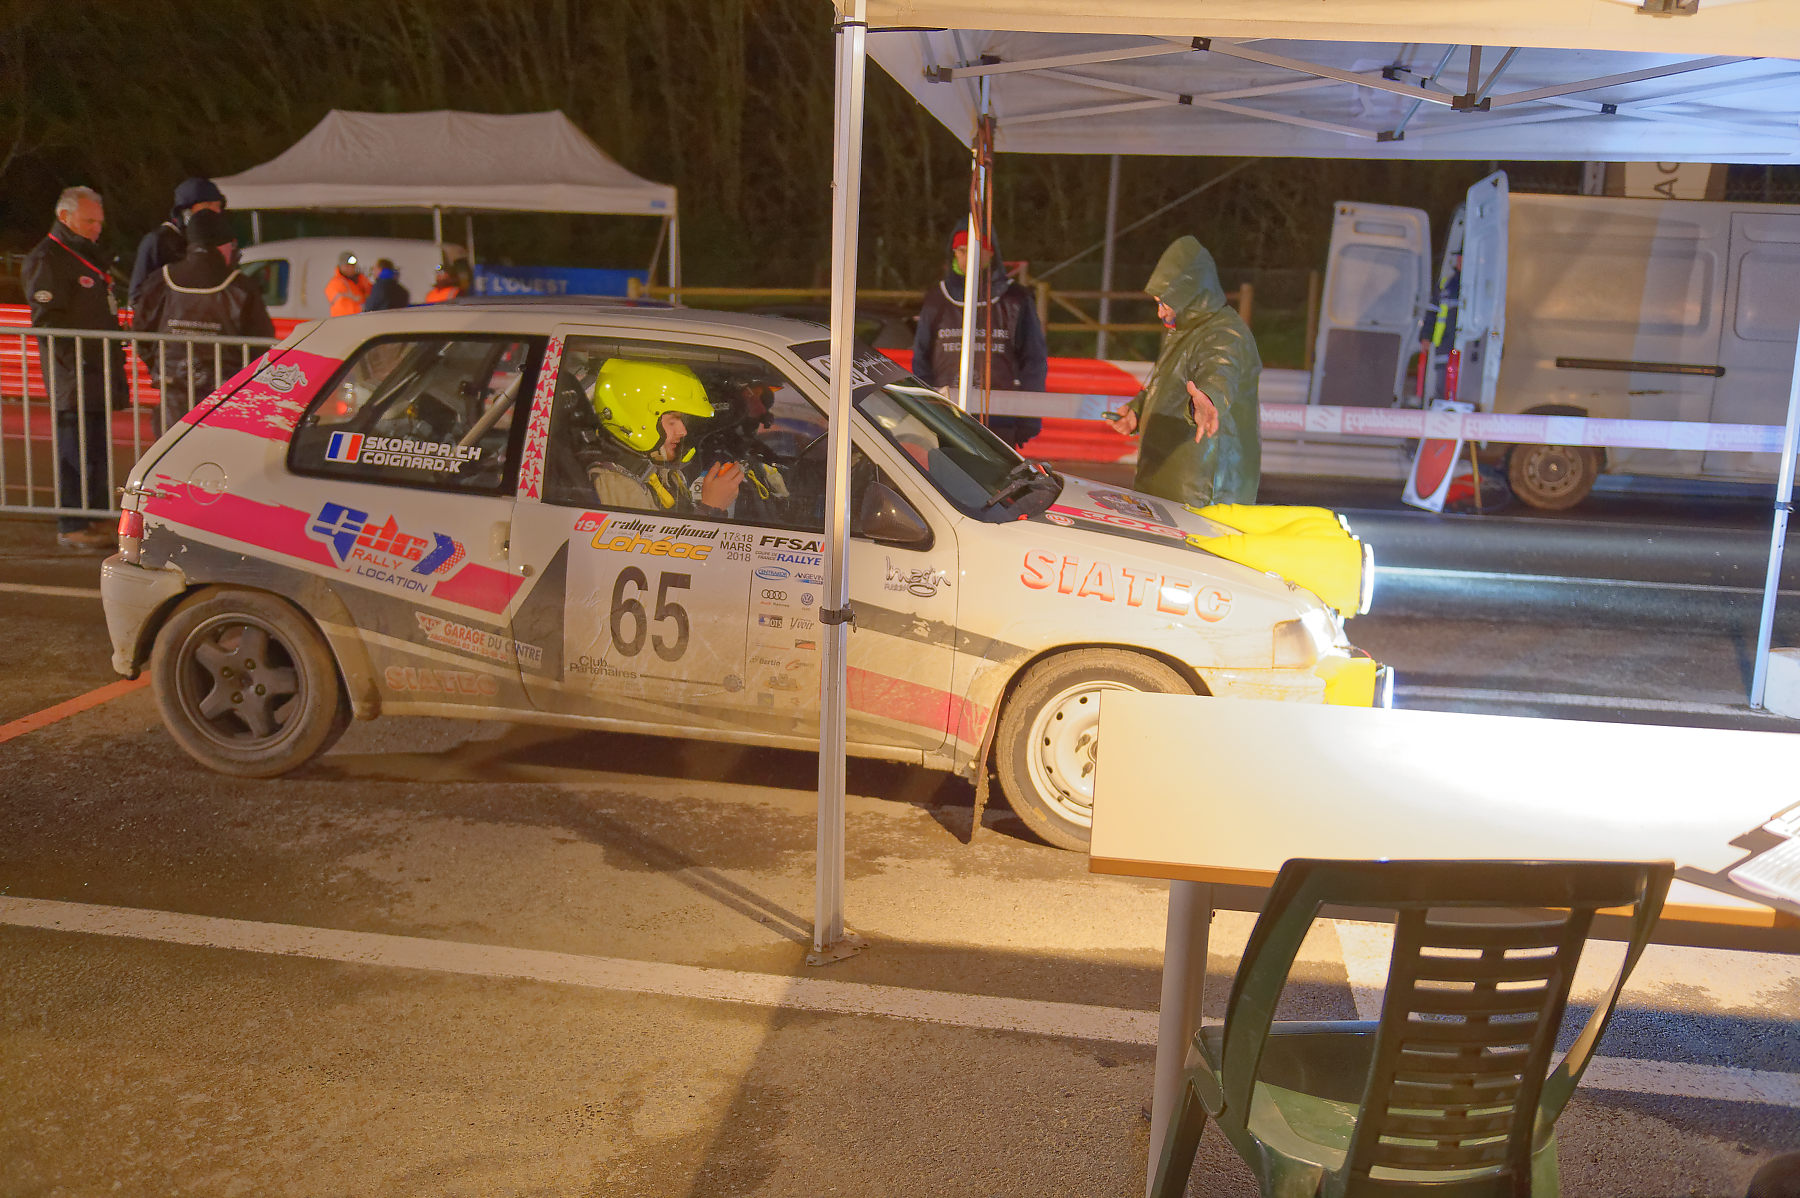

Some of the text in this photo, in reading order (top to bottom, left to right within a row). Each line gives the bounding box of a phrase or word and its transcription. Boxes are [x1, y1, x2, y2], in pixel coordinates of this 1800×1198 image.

[365, 436, 482, 461] SKORUPA.CH
[362, 451, 463, 473] COIGNARD.K
[591, 519, 713, 560] Lohéac
[610, 519, 656, 535] rallye
[659, 524, 719, 540] national
[723, 532, 753, 542] 17&18
[720, 541, 752, 552] MARS
[760, 536, 818, 552] FFSA
[352, 548, 403, 569] RALLY
[726, 552, 751, 562] 2018
[777, 553, 821, 566] RALLYE
[357, 565, 428, 592] LOCATION
[610, 565, 692, 662] 65
[444, 623, 486, 646] GARAGE
[488, 636, 502, 650] DU
[505, 640, 542, 661] CNTRE
[569, 662, 638, 679] Partenaires
[579, 655, 608, 668] Club
